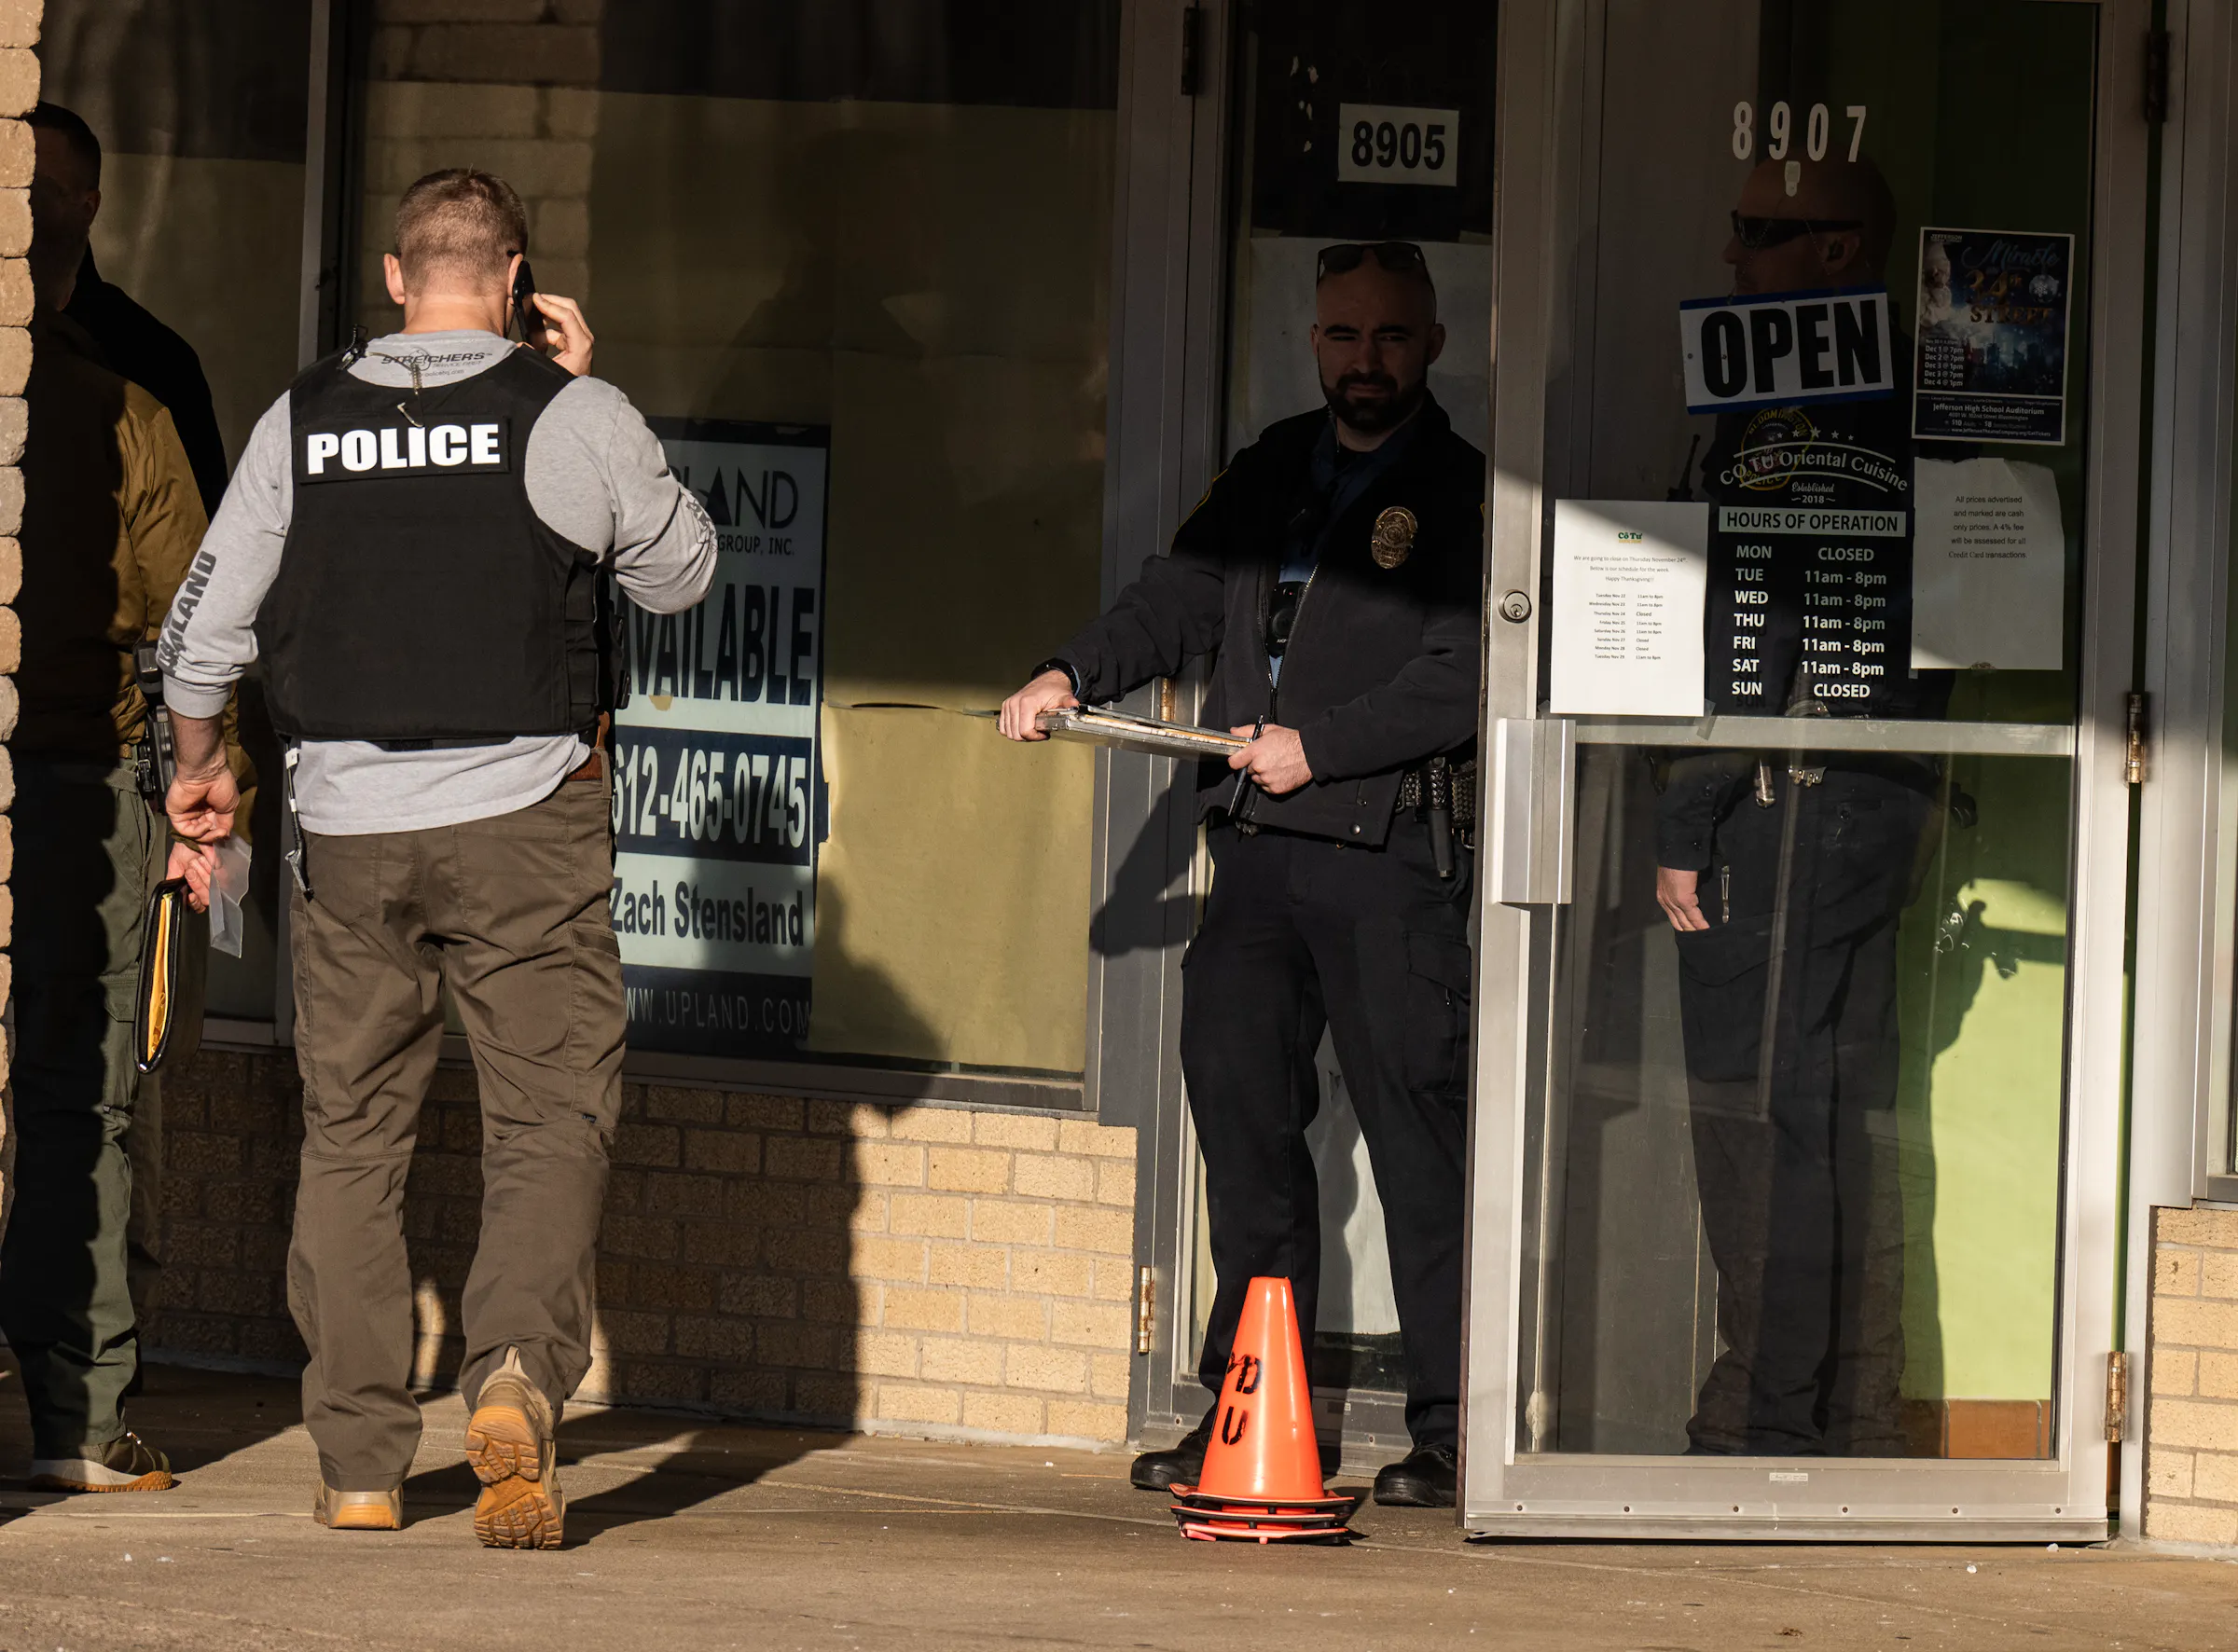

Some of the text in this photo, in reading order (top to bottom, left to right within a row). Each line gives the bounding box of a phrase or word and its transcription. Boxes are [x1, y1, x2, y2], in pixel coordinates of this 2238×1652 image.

[1732, 101, 1867, 163] 8907
[1351, 120, 1445, 170] 8905
[1700, 299, 1882, 398] OPEN
[1933, 403, 2045, 415] Jefferson High School Auditorium
[307, 423, 502, 475] POLICE
[1778, 449, 1847, 469] Oriental
[1851, 455, 1909, 492] Cuisine
[1790, 480, 1836, 495] Established
[1801, 495, 1825, 505] 2018
[1966, 496, 1986, 504] prices
[1726, 512, 1898, 531] HOURS OF OPERATION
[1968, 509, 1993, 517] marked
[1953, 524, 1968, 532] only
[768, 535, 795, 558] INC.
[1735, 545, 1875, 561] MON CLOSED
[1985, 551, 2027, 559] transactions.
[1734, 568, 1764, 582] TUE
[1804, 571, 1844, 585] 11am
[1855, 571, 1887, 587] 8pm
[1734, 590, 1769, 604] WED
[1803, 593, 1843, 607] 11am
[1854, 594, 1886, 610] 8pm
[1733, 613, 1764, 627] THU
[1803, 615, 1842, 629] 11am
[1853, 616, 1886, 633] 8pm
[1733, 636, 1756, 650] FRI
[1802, 638, 1841, 652] 11am
[1852, 639, 1885, 656] 8pm
[1732, 658, 1760, 673] SAT
[1801, 660, 1841, 675] 11am
[1852, 662, 1885, 679] 8pm
[1731, 681, 1871, 697] SUN CLOSED
[614, 743, 806, 849] 612-465-0745
[613, 876, 804, 947] Zach Stensland
